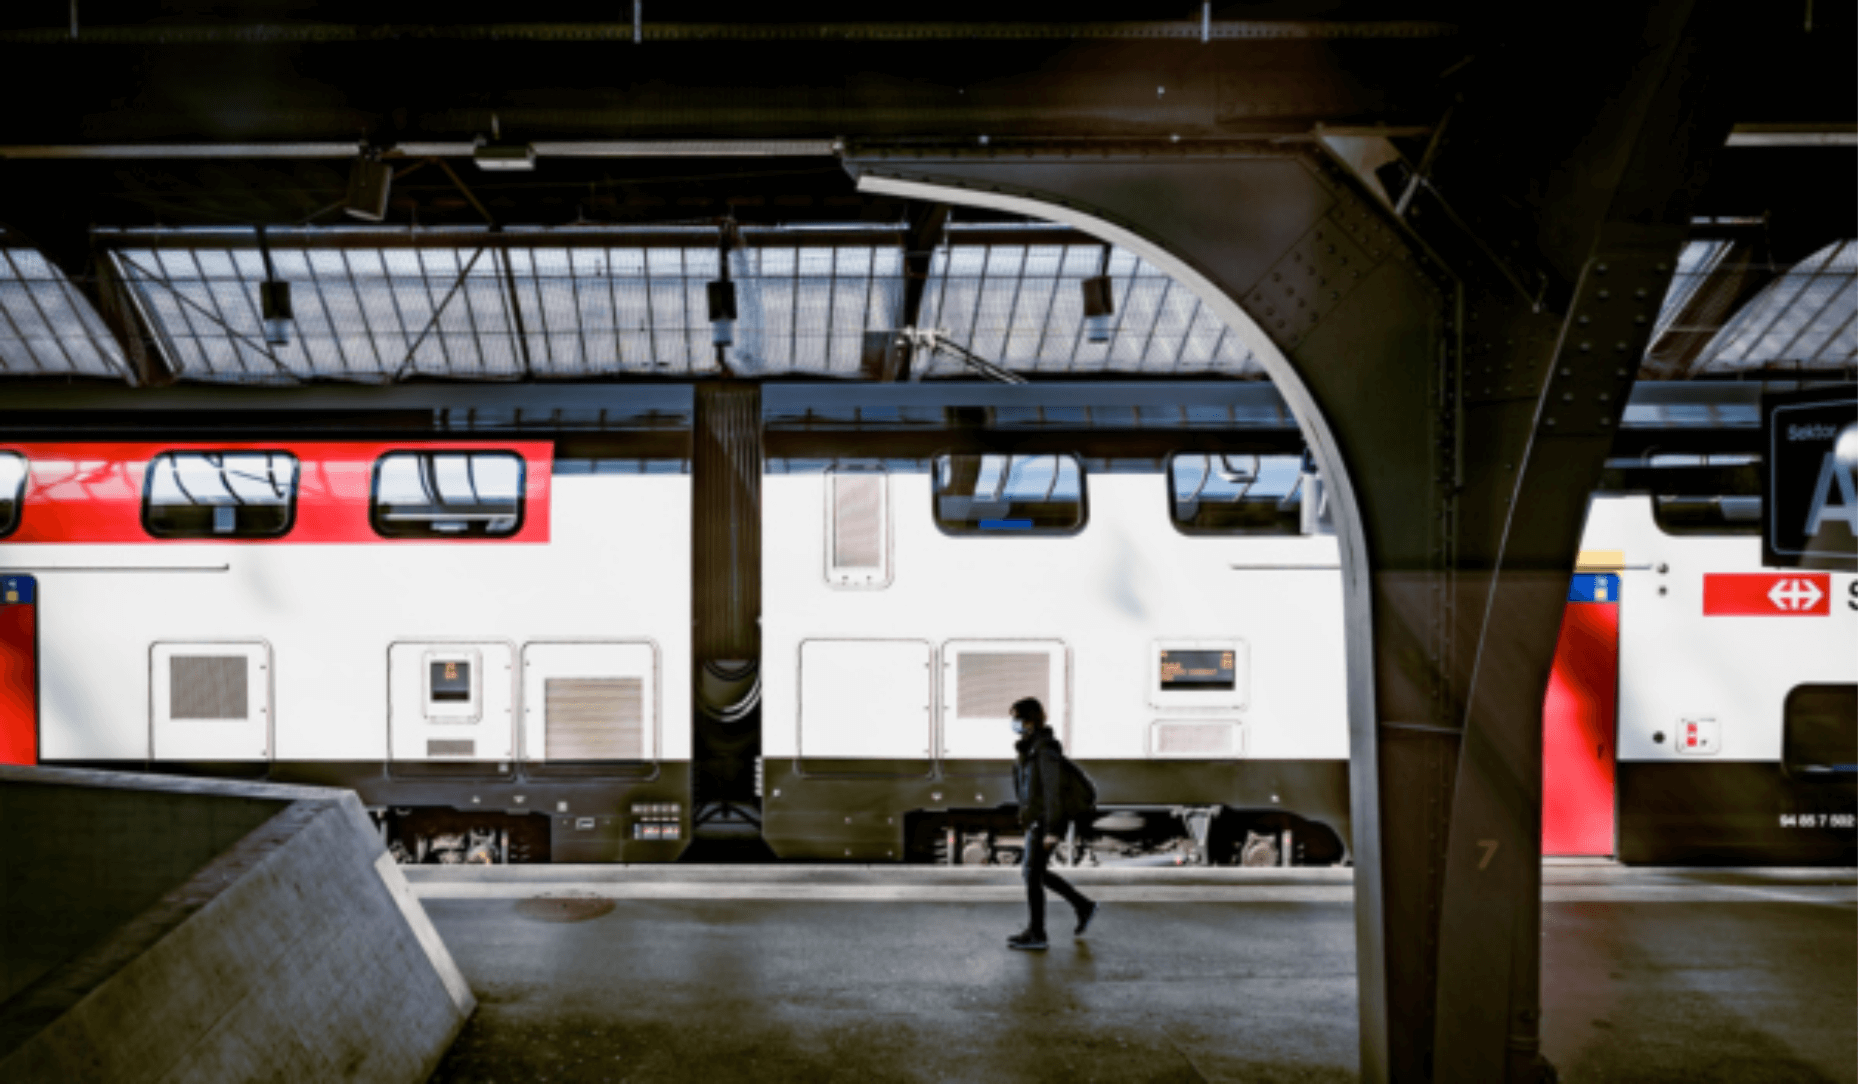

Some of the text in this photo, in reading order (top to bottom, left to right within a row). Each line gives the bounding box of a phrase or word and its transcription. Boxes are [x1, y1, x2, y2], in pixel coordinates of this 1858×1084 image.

[1787, 424, 1837, 441] Sektor
[1803, 451, 1858, 536] A
[1779, 813, 1797, 828] 94
[1818, 813, 1828, 828] 7
[1477, 839, 1498, 870] 7
